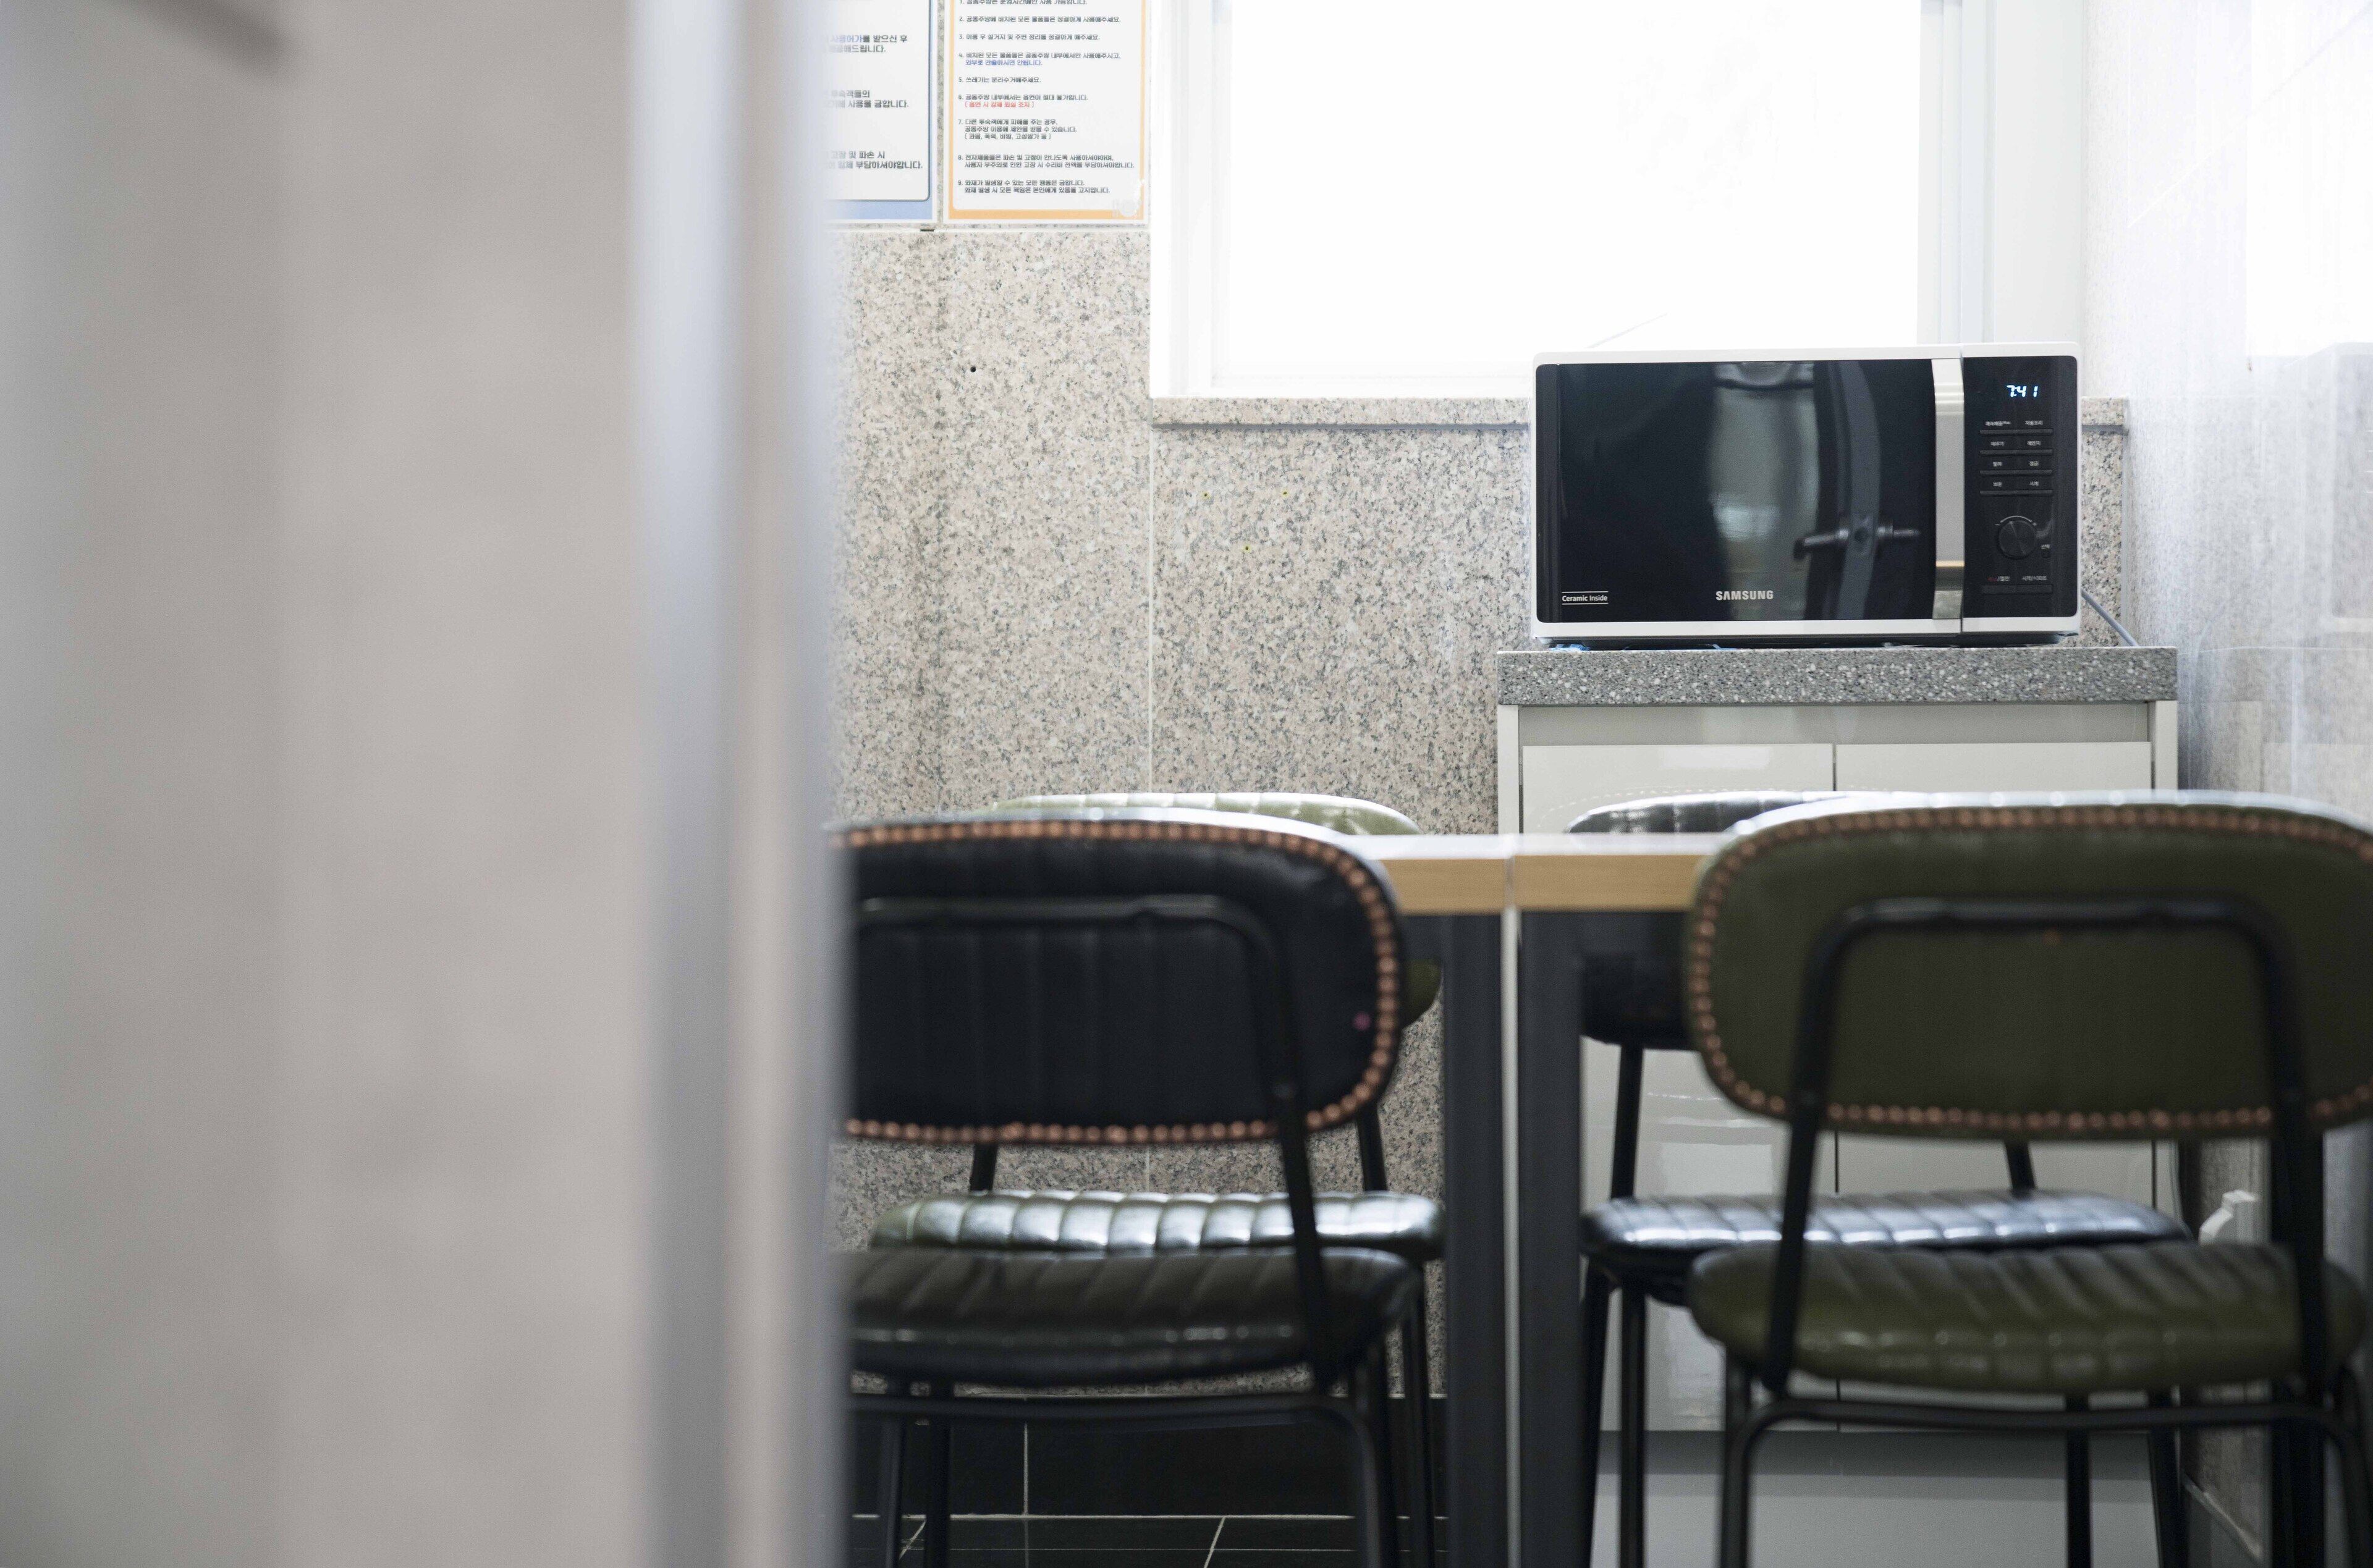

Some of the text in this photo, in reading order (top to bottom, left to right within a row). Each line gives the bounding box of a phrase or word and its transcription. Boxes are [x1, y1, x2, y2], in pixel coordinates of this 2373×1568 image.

[873, 35, 897, 43] 받으신
[900, 35, 908, 43] 후
[848, 100, 871, 108] 사용을
[874, 100, 909, 108] 금합니다.
[848, 151, 857, 159] 및
[859, 151, 874, 159] 파손
[878, 151, 886, 159] 시
[1715, 590, 1774, 601] SAMSUNG
